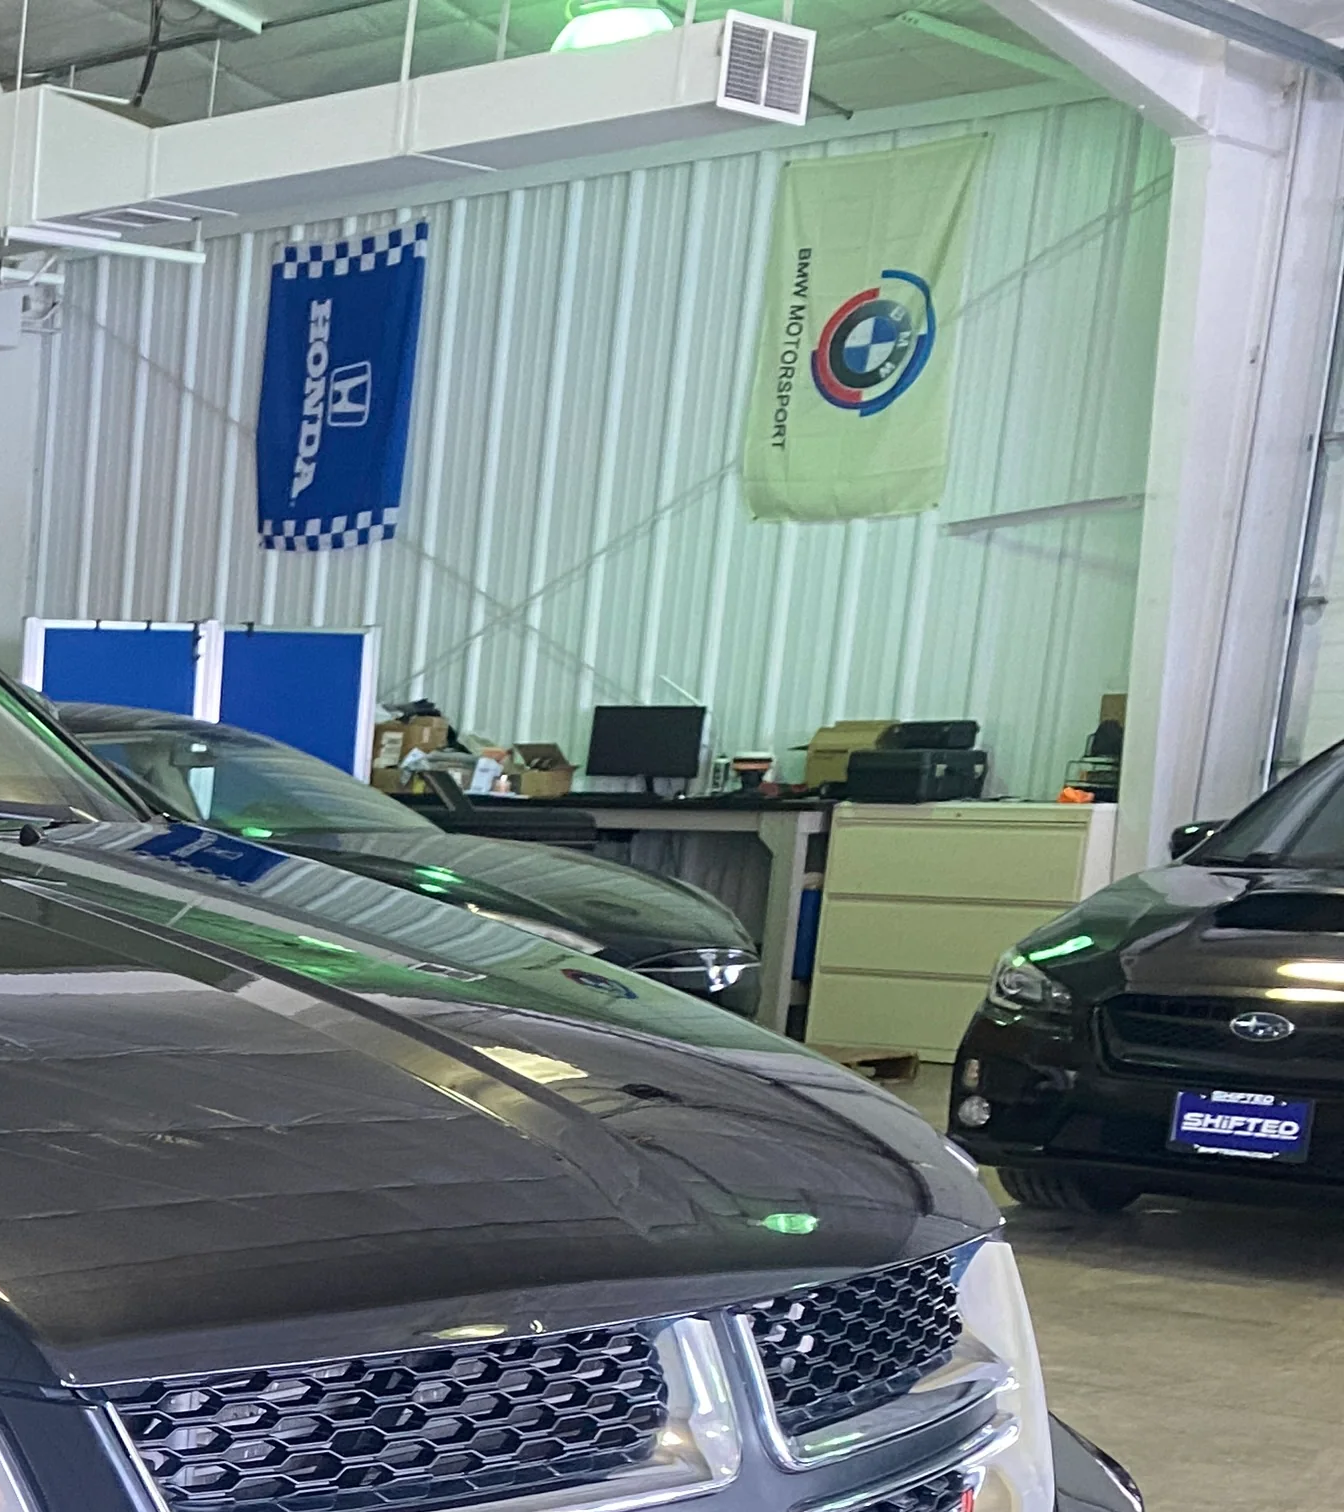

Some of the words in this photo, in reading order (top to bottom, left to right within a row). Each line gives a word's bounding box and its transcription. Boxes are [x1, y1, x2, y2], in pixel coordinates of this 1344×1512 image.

[796, 248, 812, 300] BMW
[291, 299, 332, 500] HONDA
[772, 307, 806, 451] MOTORSPORT
